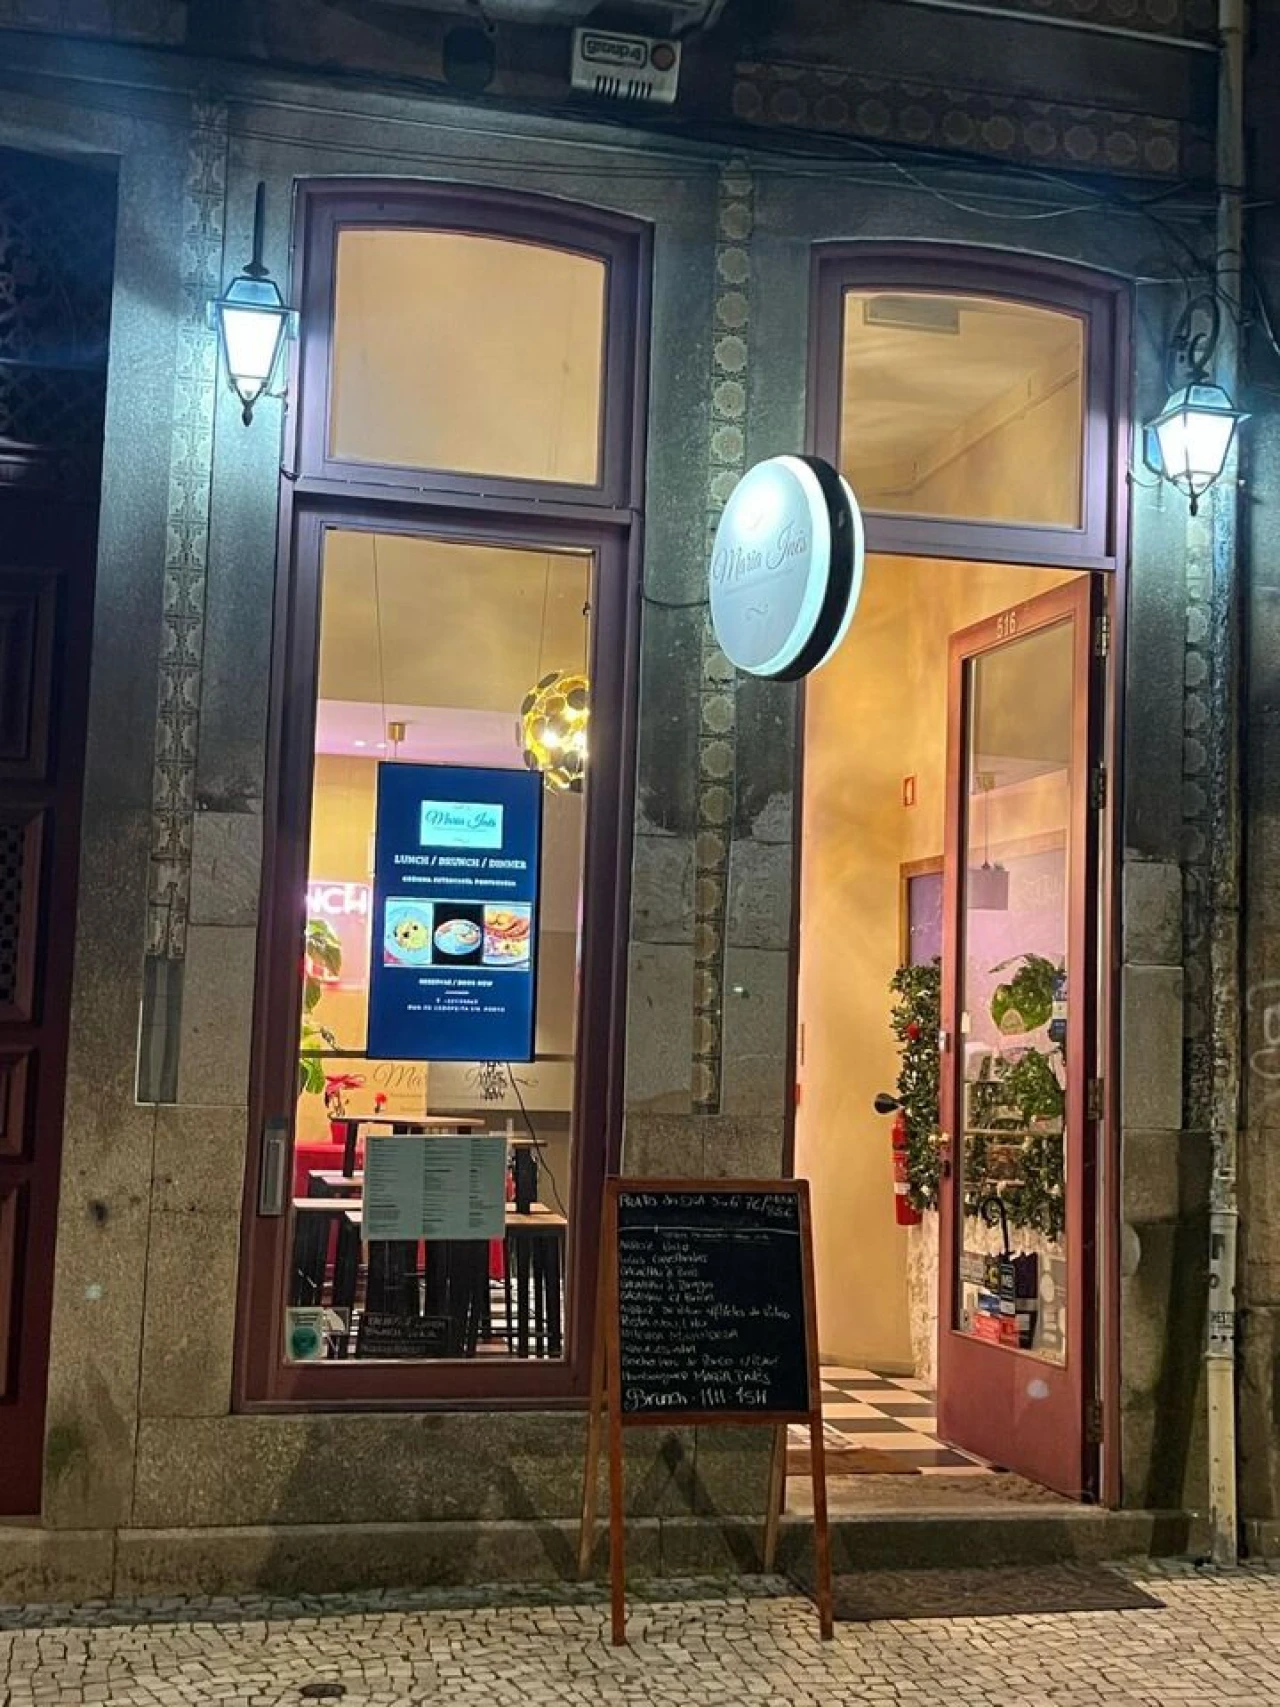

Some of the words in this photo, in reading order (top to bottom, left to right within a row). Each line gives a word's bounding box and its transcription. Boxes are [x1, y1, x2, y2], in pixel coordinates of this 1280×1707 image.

[711, 546, 762, 584] Maria
[766, 519, 807, 570] Inês
[996, 611, 1017, 640] 516
[424, 810, 465, 826] Maria
[394, 854, 429, 865] LUNCH
[438, 856, 480, 868] BRUNCH
[488, 858, 527, 870] DINNER
